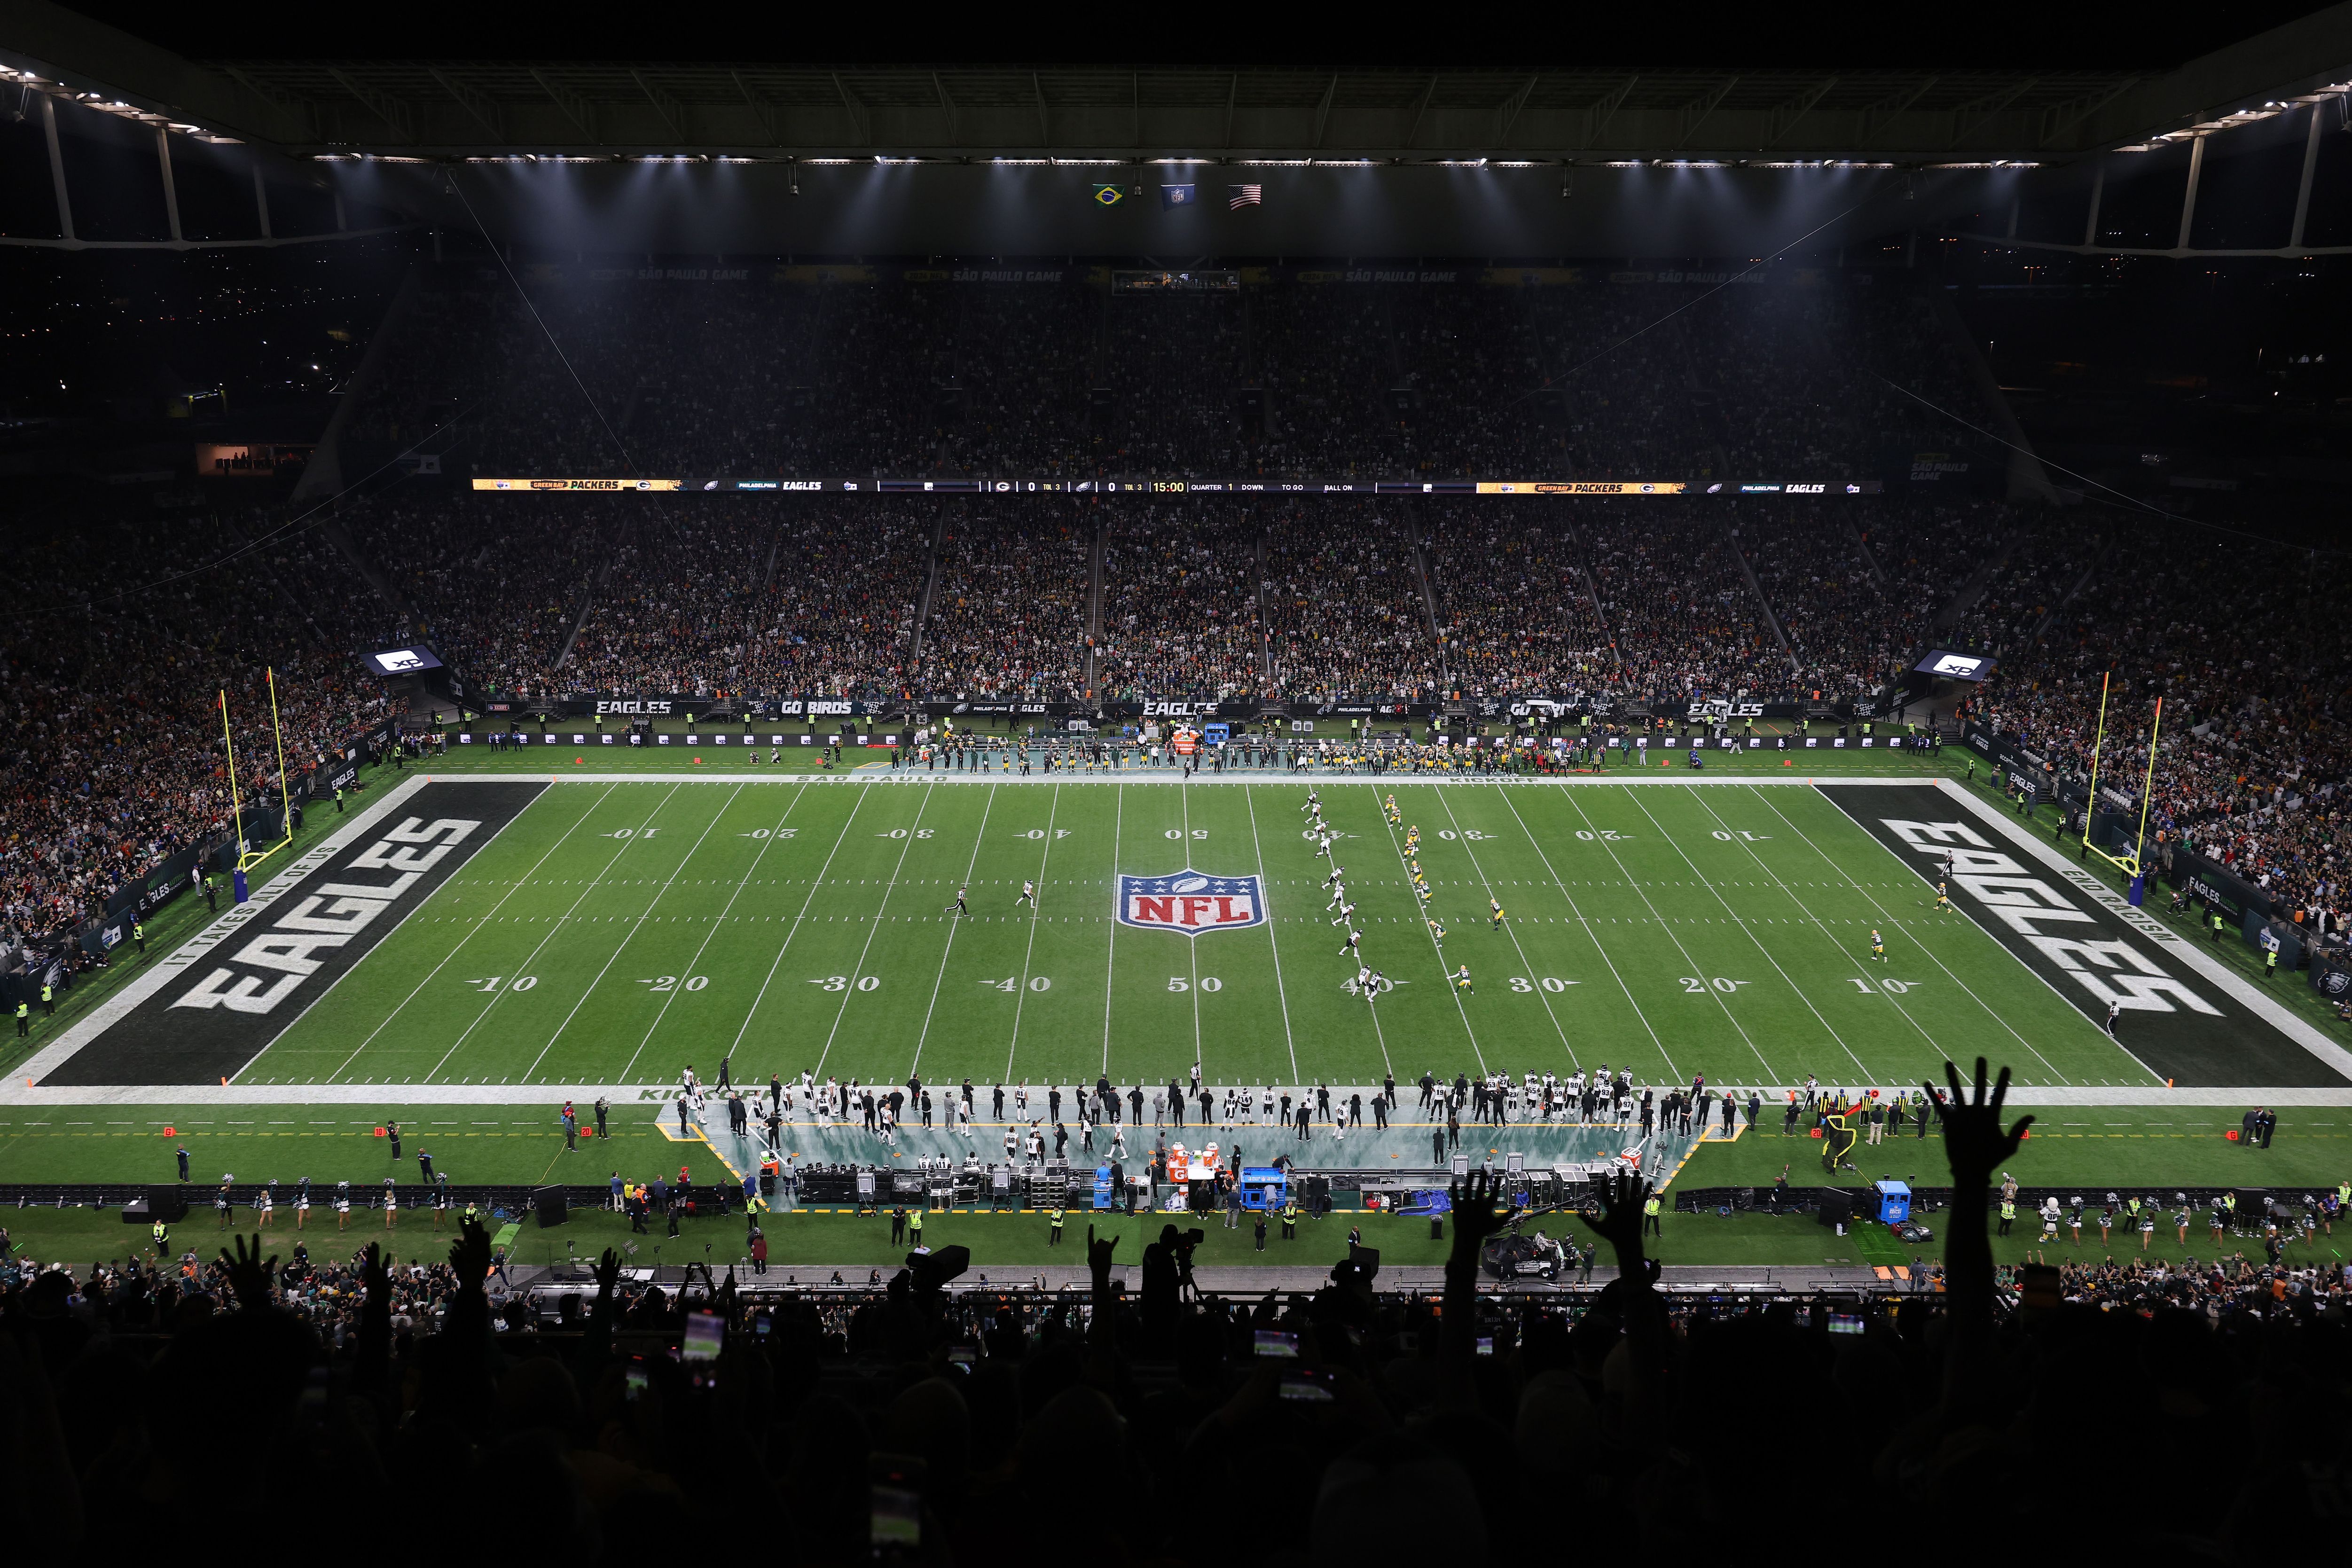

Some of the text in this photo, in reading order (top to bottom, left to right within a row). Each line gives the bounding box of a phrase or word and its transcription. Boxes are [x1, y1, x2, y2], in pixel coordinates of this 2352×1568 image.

[667, 270, 707, 280] PAULO
[713, 270, 749, 280] GAME
[953, 268, 1063, 282] SÃO PAULO GAME
[1346, 268, 1457, 282] SÃO PAULO GAME
[1686, 273, 1727, 282] PAULO
[783, 481, 822, 490] EAGLES
[1028, 482, 1035, 491] 0
[1109, 482, 1116, 491] 0
[1153, 482, 1184, 492] 15:00
[1786, 484, 1825, 493] EAGLES
[596, 701, 672, 714] EAGLES
[781, 701, 853, 714] GO BIRDS
[1976, 739, 1989, 751] EAGLES
[331, 767, 355, 791] EAGLES
[2010, 772, 2036, 792] EAGLES
[613, 829, 661, 839] 10
[752, 829, 799, 839] 20
[890, 829, 935, 839] 30
[1027, 830, 1073, 839] 40
[1165, 830, 1209, 840] 50
[1438, 830, 1486, 840] 30
[1575, 830, 1622, 840] 20
[1711, 831, 1761, 841] 10
[140, 872, 185, 911] EGLES AUTISM
[2189, 876, 2220, 903] EAGLES
[164, 847, 337, 965] IT TAKES ALL OF US
[1135, 897, 1249, 925] NFL
[2062, 870, 2180, 941] END RACISM
[165, 816, 483, 1014] EAGLES
[1878, 818, 2227, 1017] EAGLES
[476, 976, 537, 991] 10
[650, 976, 709, 991] 20
[823, 977, 880, 991] 30
[996, 977, 1051, 992] 40
[1168, 977, 1222, 992] 50
[1509, 978, 1565, 992] 30
[1679, 978, 1737, 992] 20
[1846, 979, 1909, 993] 10
